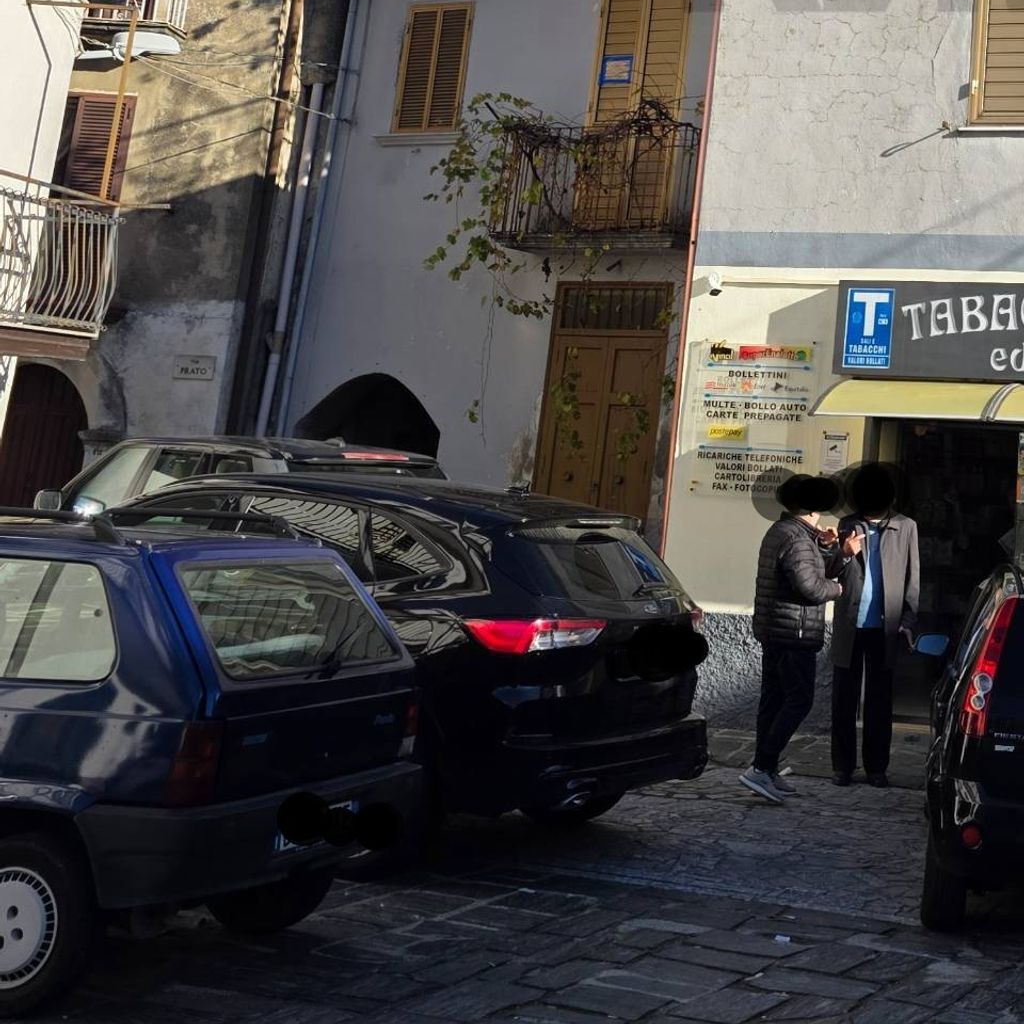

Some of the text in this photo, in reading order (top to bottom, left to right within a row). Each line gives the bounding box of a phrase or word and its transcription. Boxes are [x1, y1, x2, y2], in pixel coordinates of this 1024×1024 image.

[854, 293, 890, 336] T
[848, 344, 887, 354] TABACCHI
[180, 367, 208, 376] PRATO
[728, 370, 788, 379] BOLLETTINI
[703, 400, 807, 412] MULTE BOLLO AUTO
[706, 410, 801, 422] CARTE PREPAGATE
[697, 451, 804, 464] RICARICHE TELEFONICHE
[715, 462, 783, 473] VALORI BOLLATI
[714, 472, 781, 483] CARTOLIBRERIA
[712, 482, 728, 491] FAX
